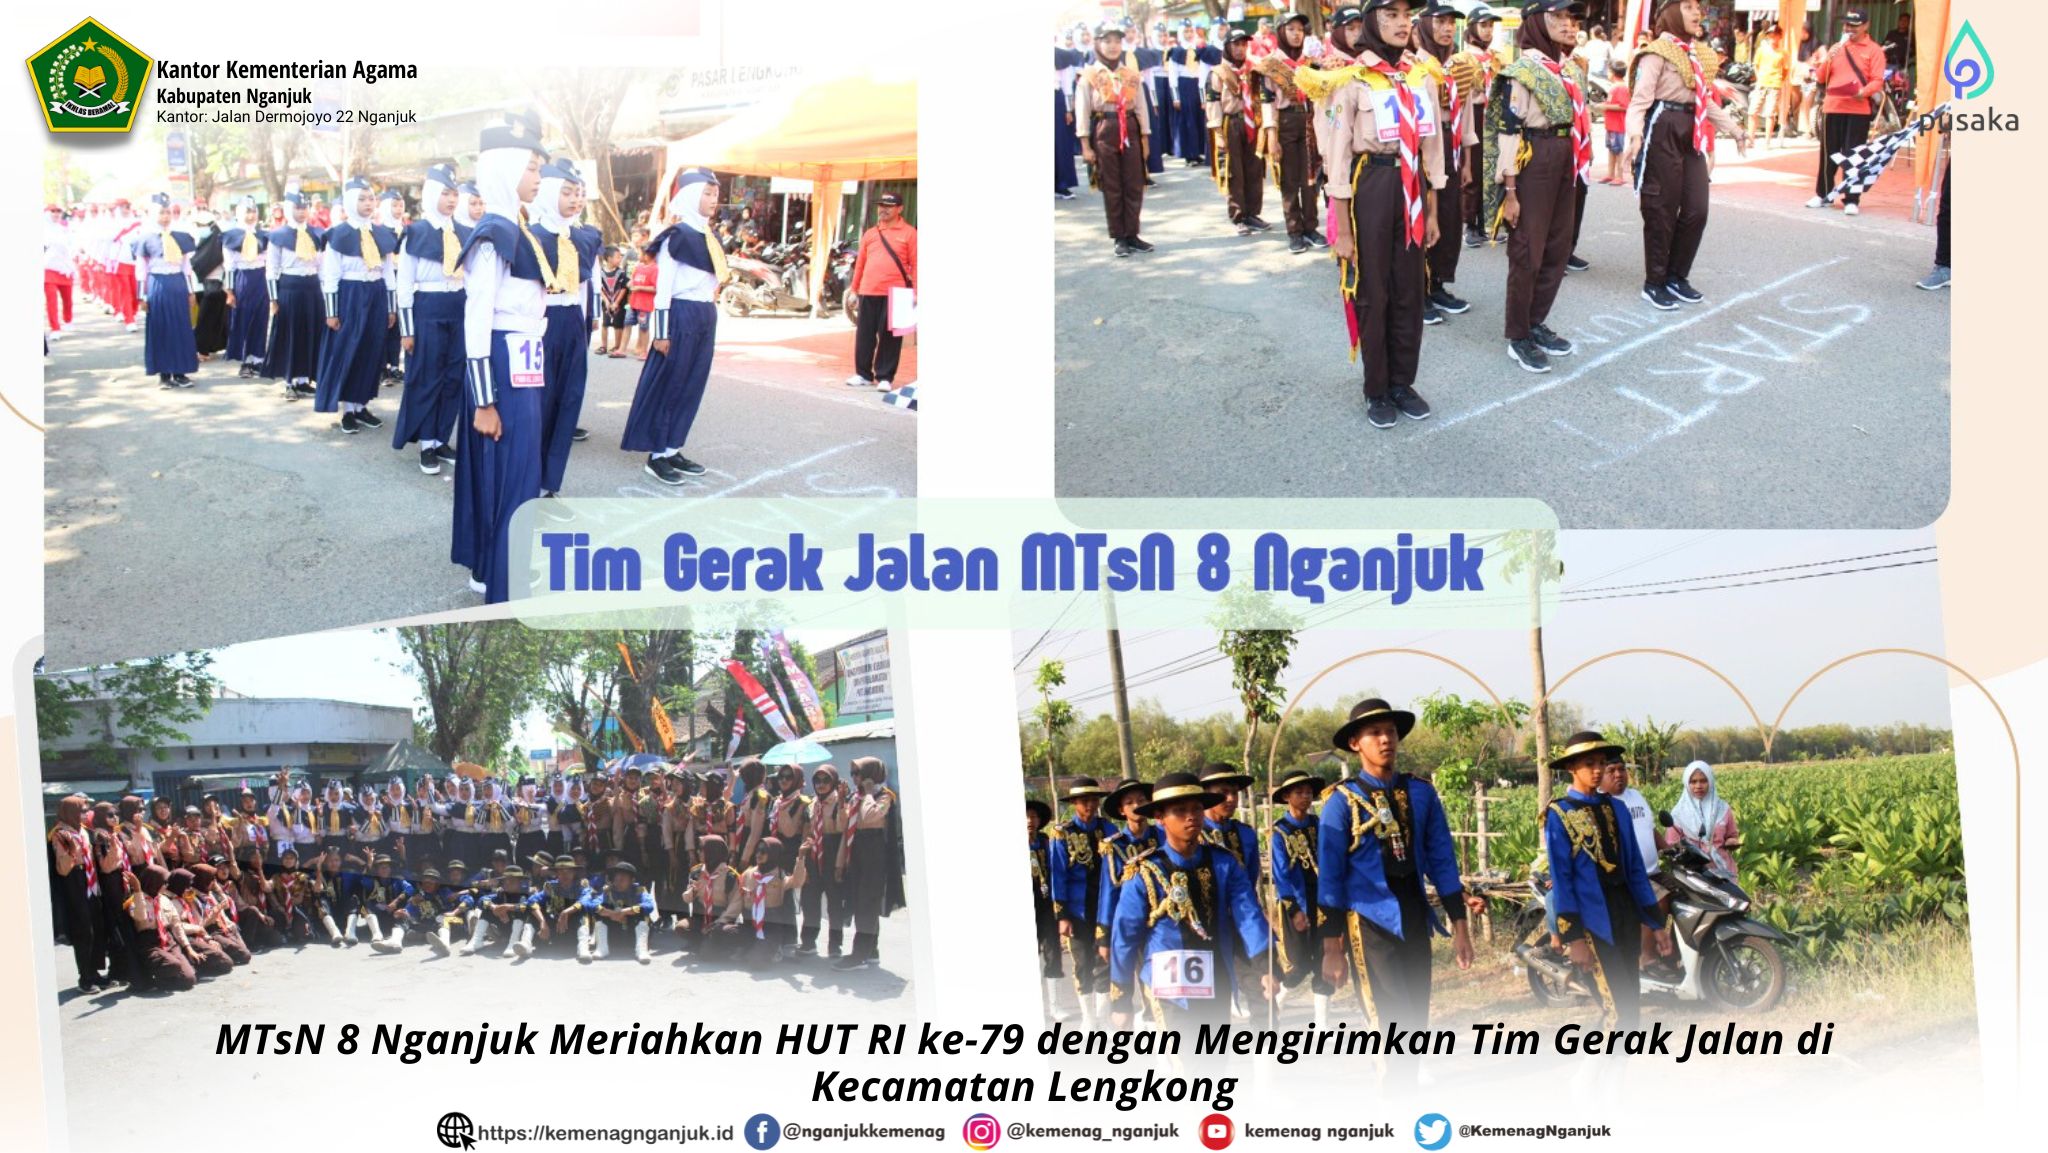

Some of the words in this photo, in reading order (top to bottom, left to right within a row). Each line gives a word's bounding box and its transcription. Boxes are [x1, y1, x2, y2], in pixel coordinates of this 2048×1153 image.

[690, 67, 728, 89] PASAR
[519, 339, 543, 370] 15
[1163, 956, 1204, 984] 16
